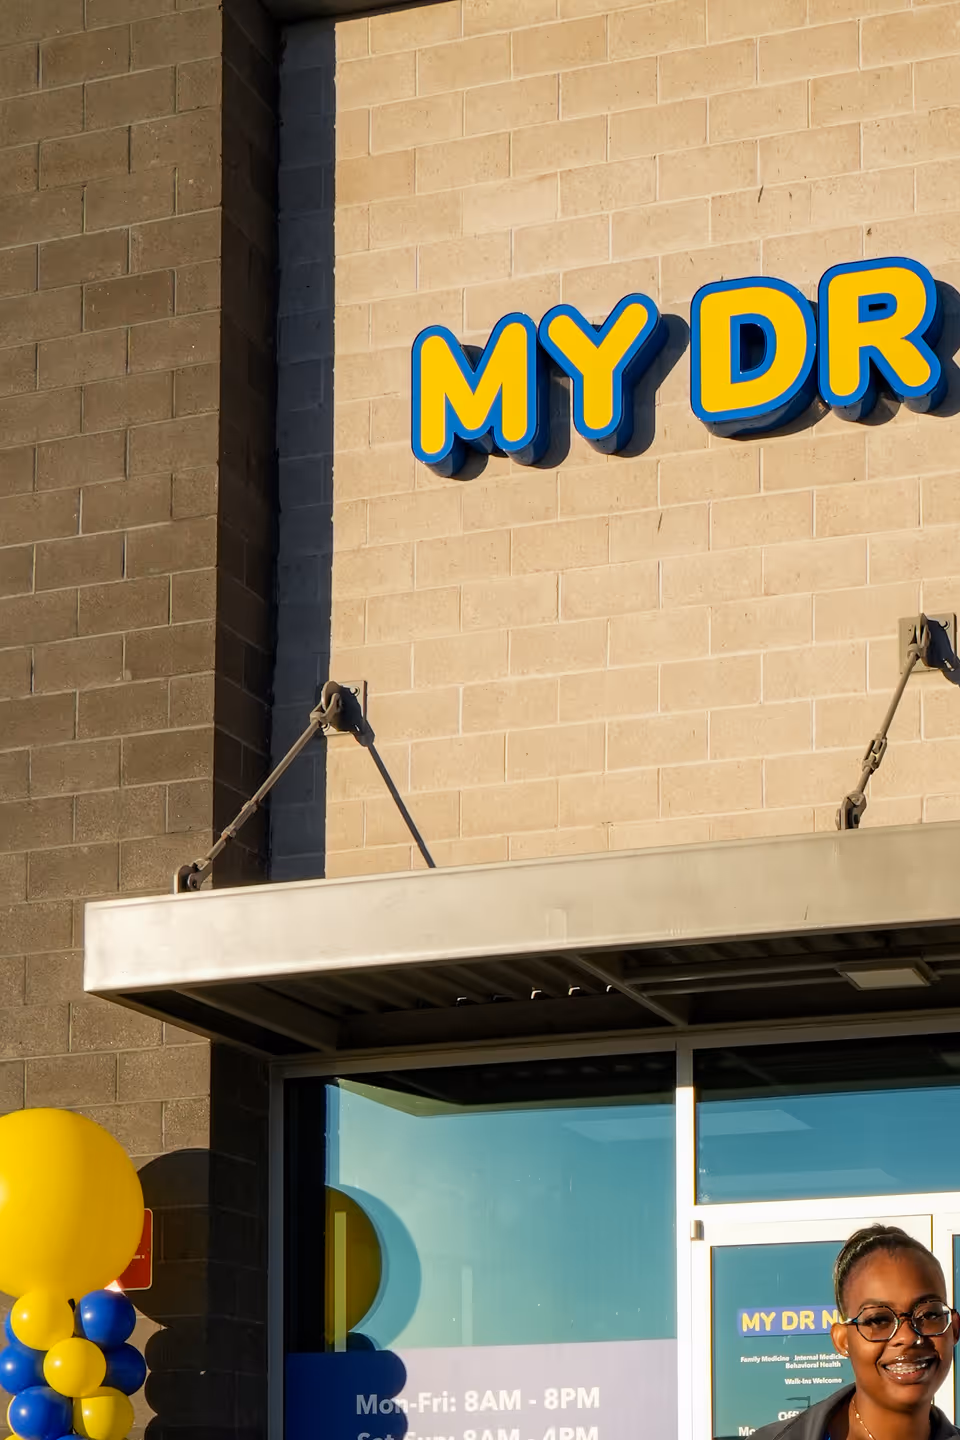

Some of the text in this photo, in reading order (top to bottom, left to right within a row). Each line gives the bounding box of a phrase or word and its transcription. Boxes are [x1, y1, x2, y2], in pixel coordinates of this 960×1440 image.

[411, 292, 661, 464] MY
[690, 256, 942, 422] DR
[742, 1309, 844, 1332] MY DR N
[819, 1360, 842, 1368] Health
[356, 1390, 456, 1415] Mon-Fri:
[464, 1389, 521, 1412] 8AM
[543, 1386, 600, 1410] 8PM
